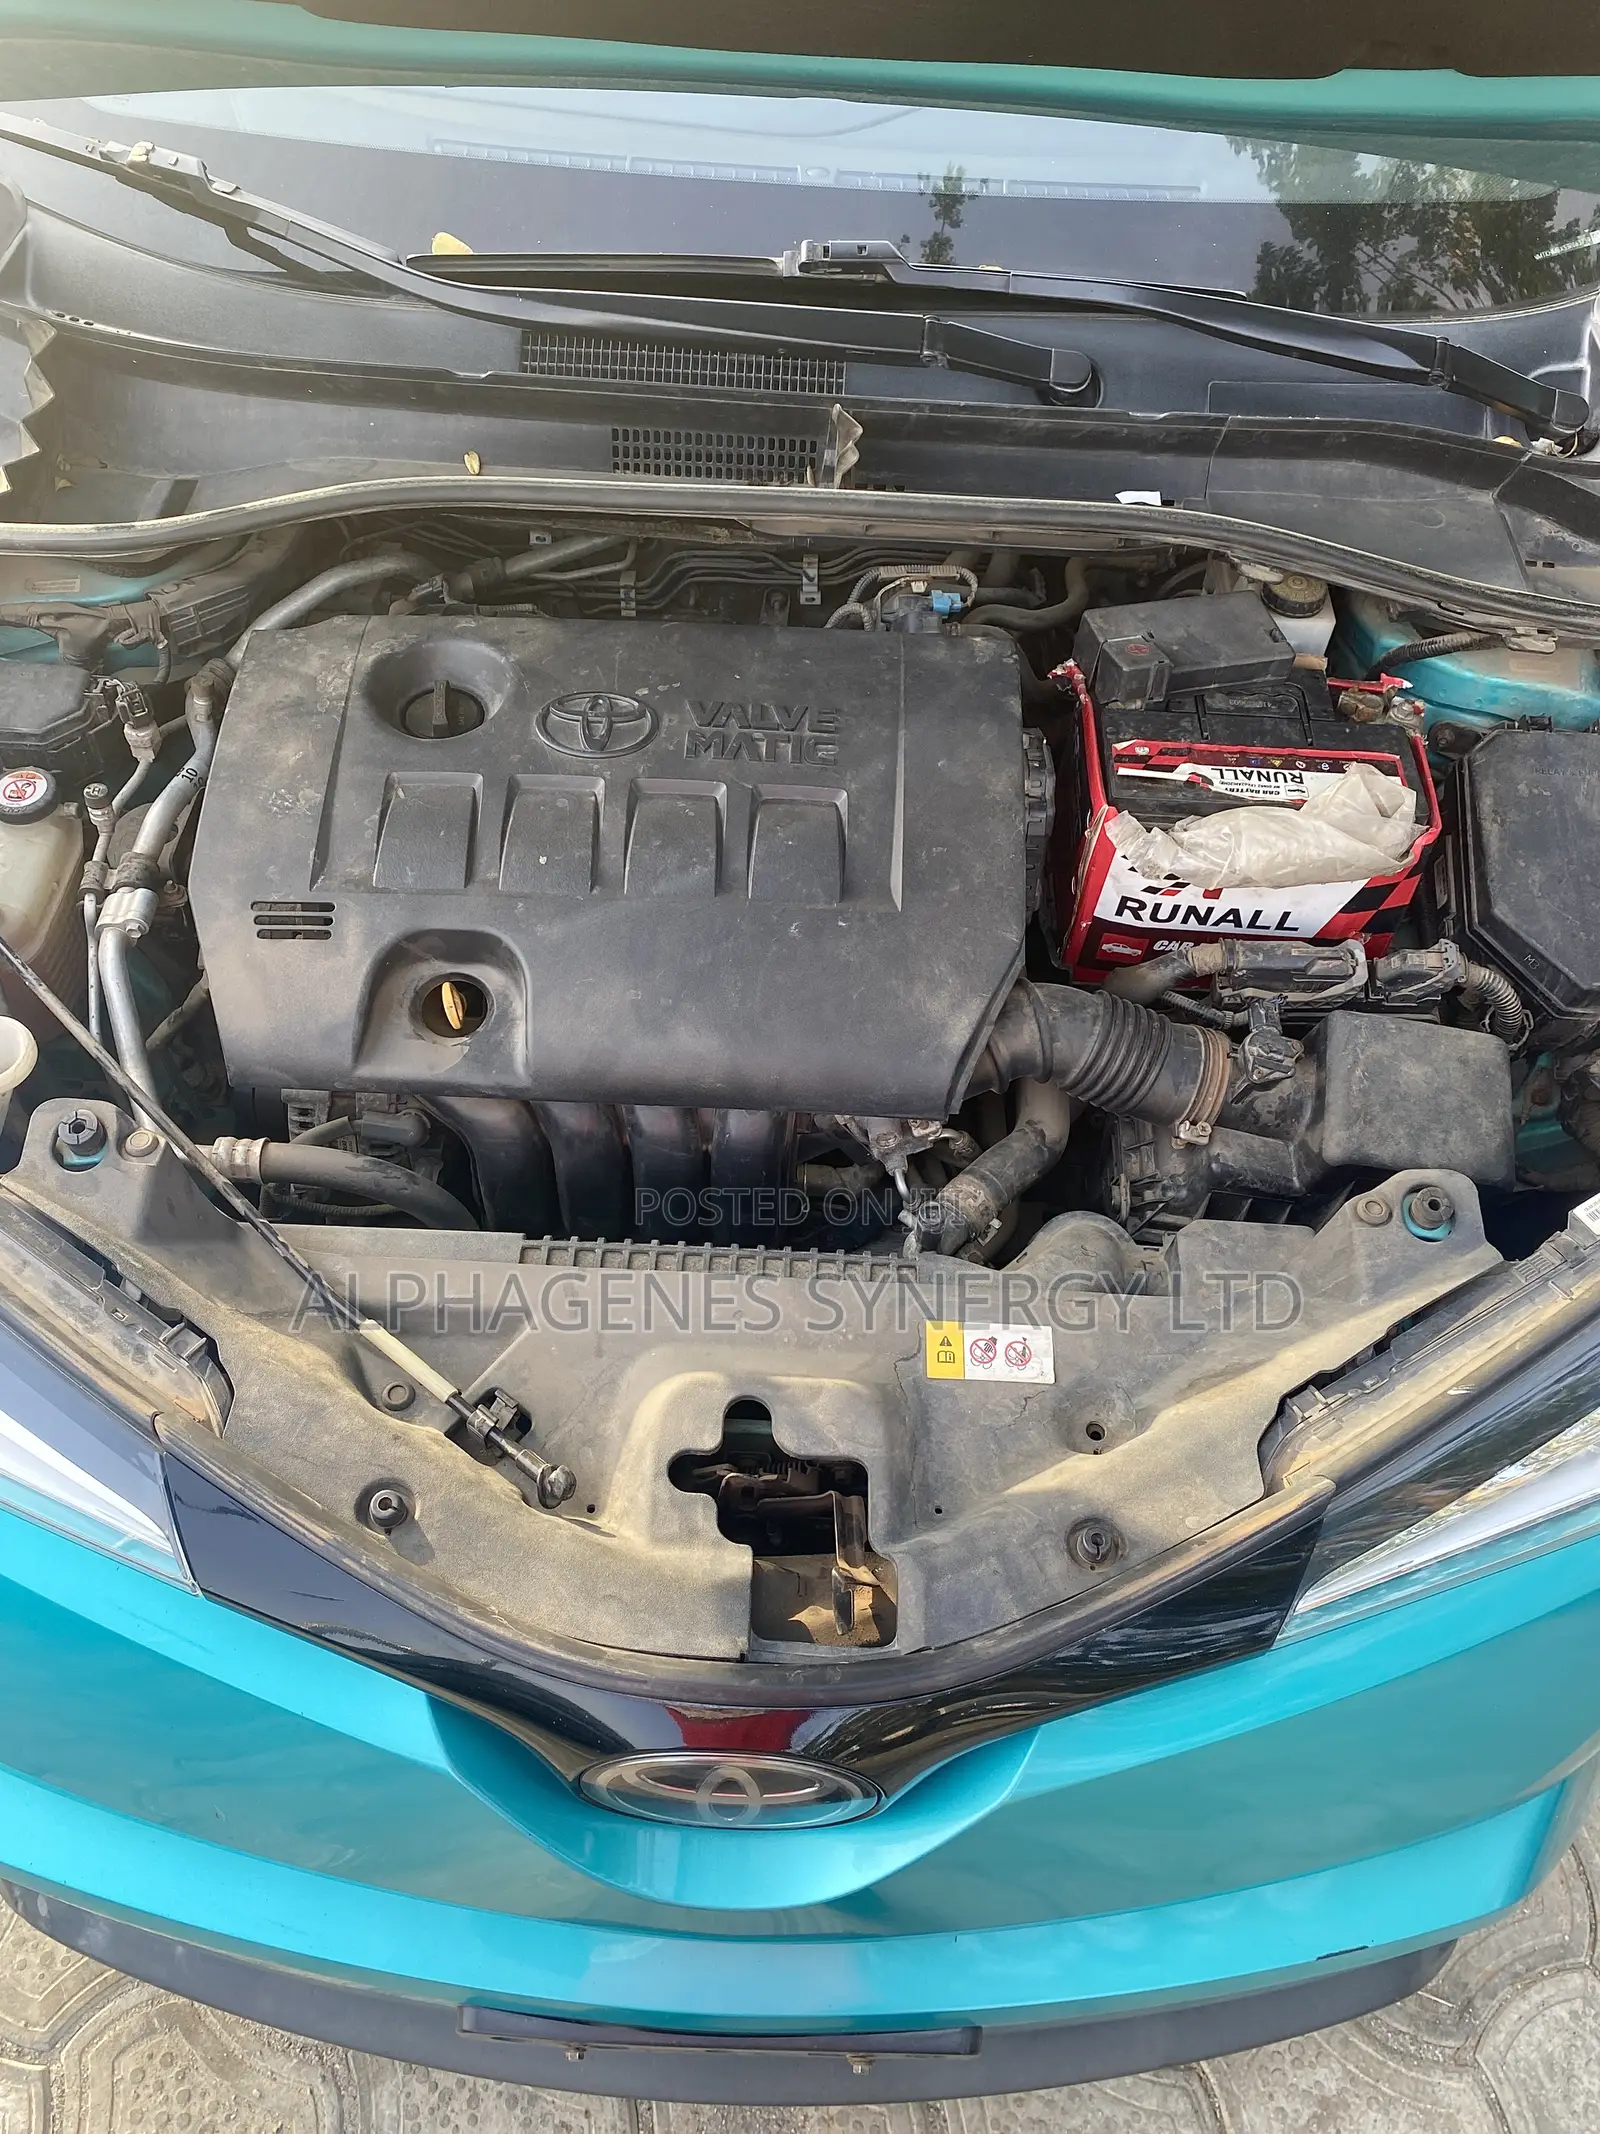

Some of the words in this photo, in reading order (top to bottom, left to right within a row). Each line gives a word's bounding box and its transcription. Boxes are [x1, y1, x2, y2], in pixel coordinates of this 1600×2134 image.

[685, 700, 838, 736] VALVE
[684, 731, 838, 765] MATIC
[181, 767, 198, 784] 10
[1211, 768, 1304, 784] RUNALL
[1115, 895, 1300, 932] RUNALL
